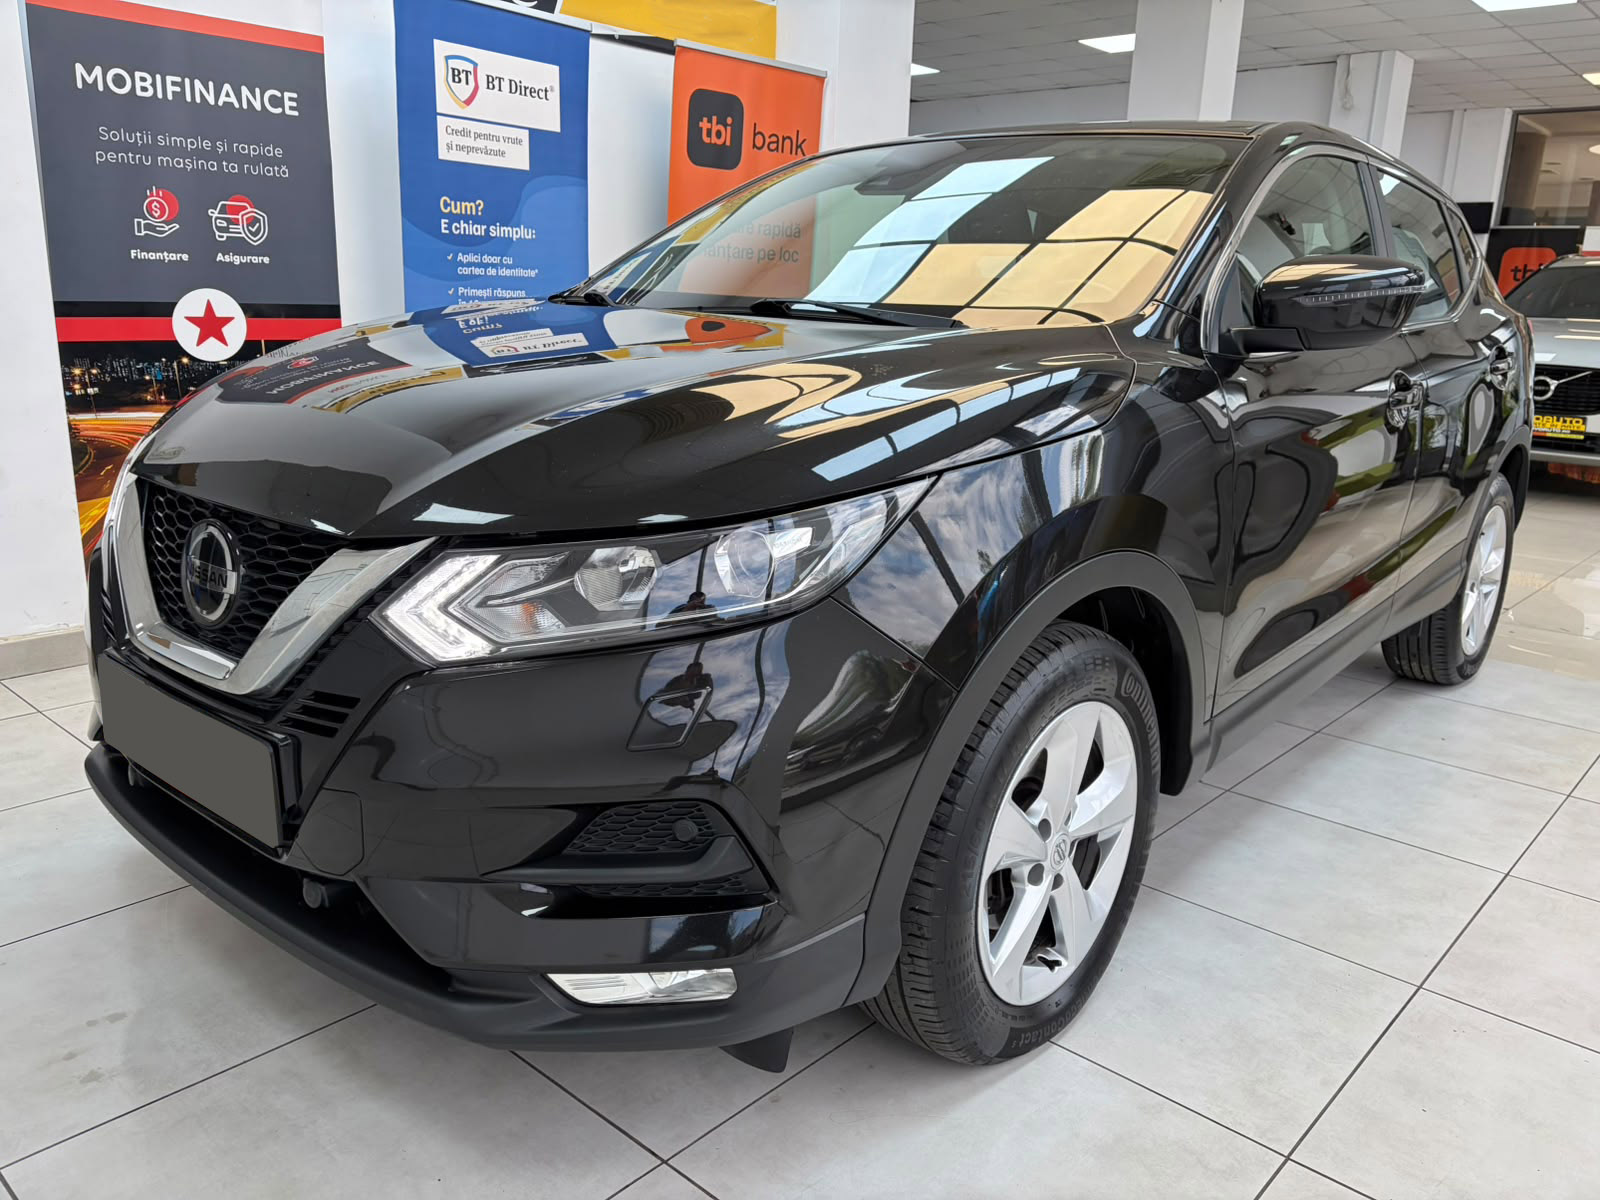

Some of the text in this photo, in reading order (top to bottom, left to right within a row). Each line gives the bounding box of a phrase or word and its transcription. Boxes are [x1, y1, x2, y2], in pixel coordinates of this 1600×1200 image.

[451, 67, 472, 86] BT
[485, 74, 504, 92] BT
[74, 62, 299, 117] MOBIFINANCE
[445, 125, 523, 146] Credit pentru vrute
[698, 115, 733, 147] tbi
[752, 122, 808, 157] bank
[157, 133, 212, 151] simple
[233, 142, 284, 159] rapide
[455, 141, 506, 158] neprevăzute
[95, 149, 289, 179] pentru mașina ta rulată
[440, 196, 484, 216] Cum?
[441, 219, 536, 241] E chiar simplu:
[130, 249, 189, 262] Finanțare
[216, 252, 270, 265] Asigurare
[457, 252, 513, 264] Aplici doar cu
[757, 248, 777, 265] pe
[779, 246, 800, 263] loc
[457, 267, 485, 276] cartea
[486, 267, 497, 276] de
